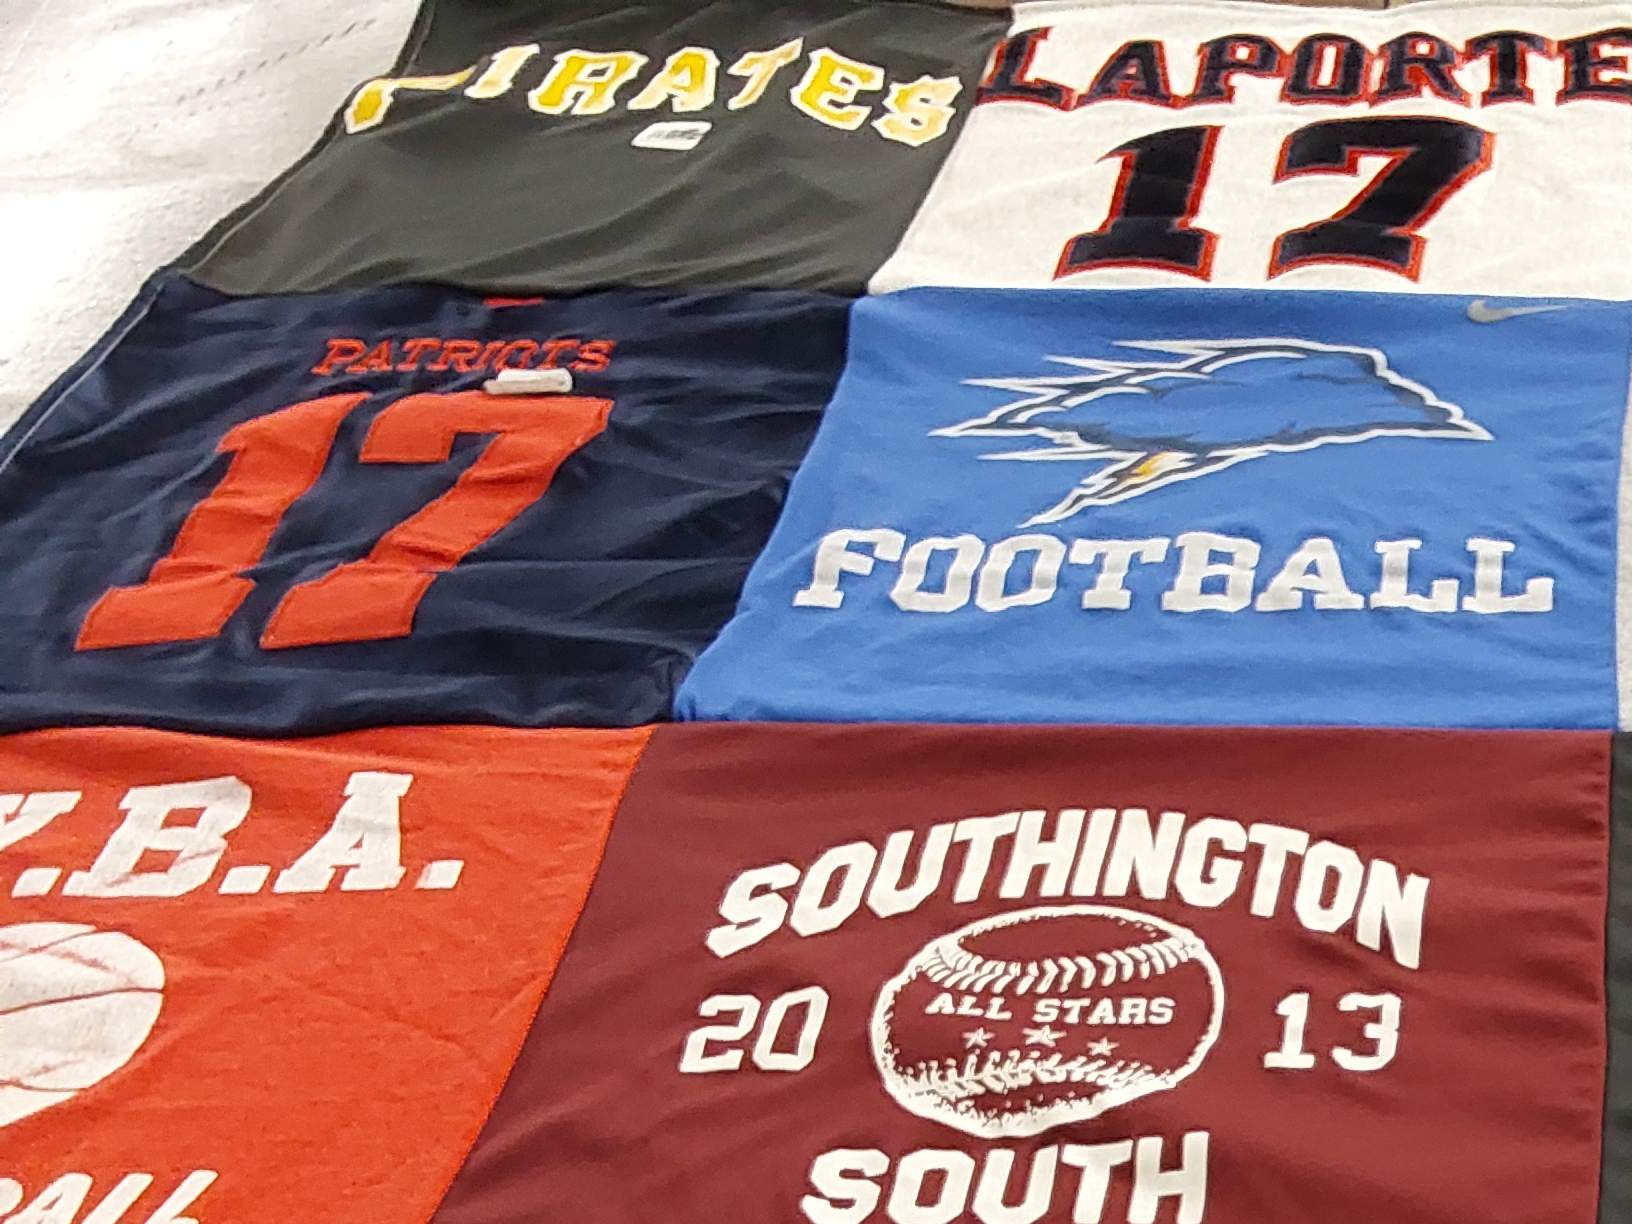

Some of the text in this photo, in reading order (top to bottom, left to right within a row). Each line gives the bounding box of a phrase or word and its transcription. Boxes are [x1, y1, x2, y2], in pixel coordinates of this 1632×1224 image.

[1053, 115, 1495, 282] 17
[312, 337, 616, 375] PATRIOTS
[75, 391, 614, 651] 17
[793, 528, 1555, 614] FOOTBALL
[707, 808, 1429, 969] SOUTHINGTON
[679, 986, 829, 1073] 20
[925, 992, 1176, 1025] ALL STARS
[1264, 993, 1401, 1070] 13
